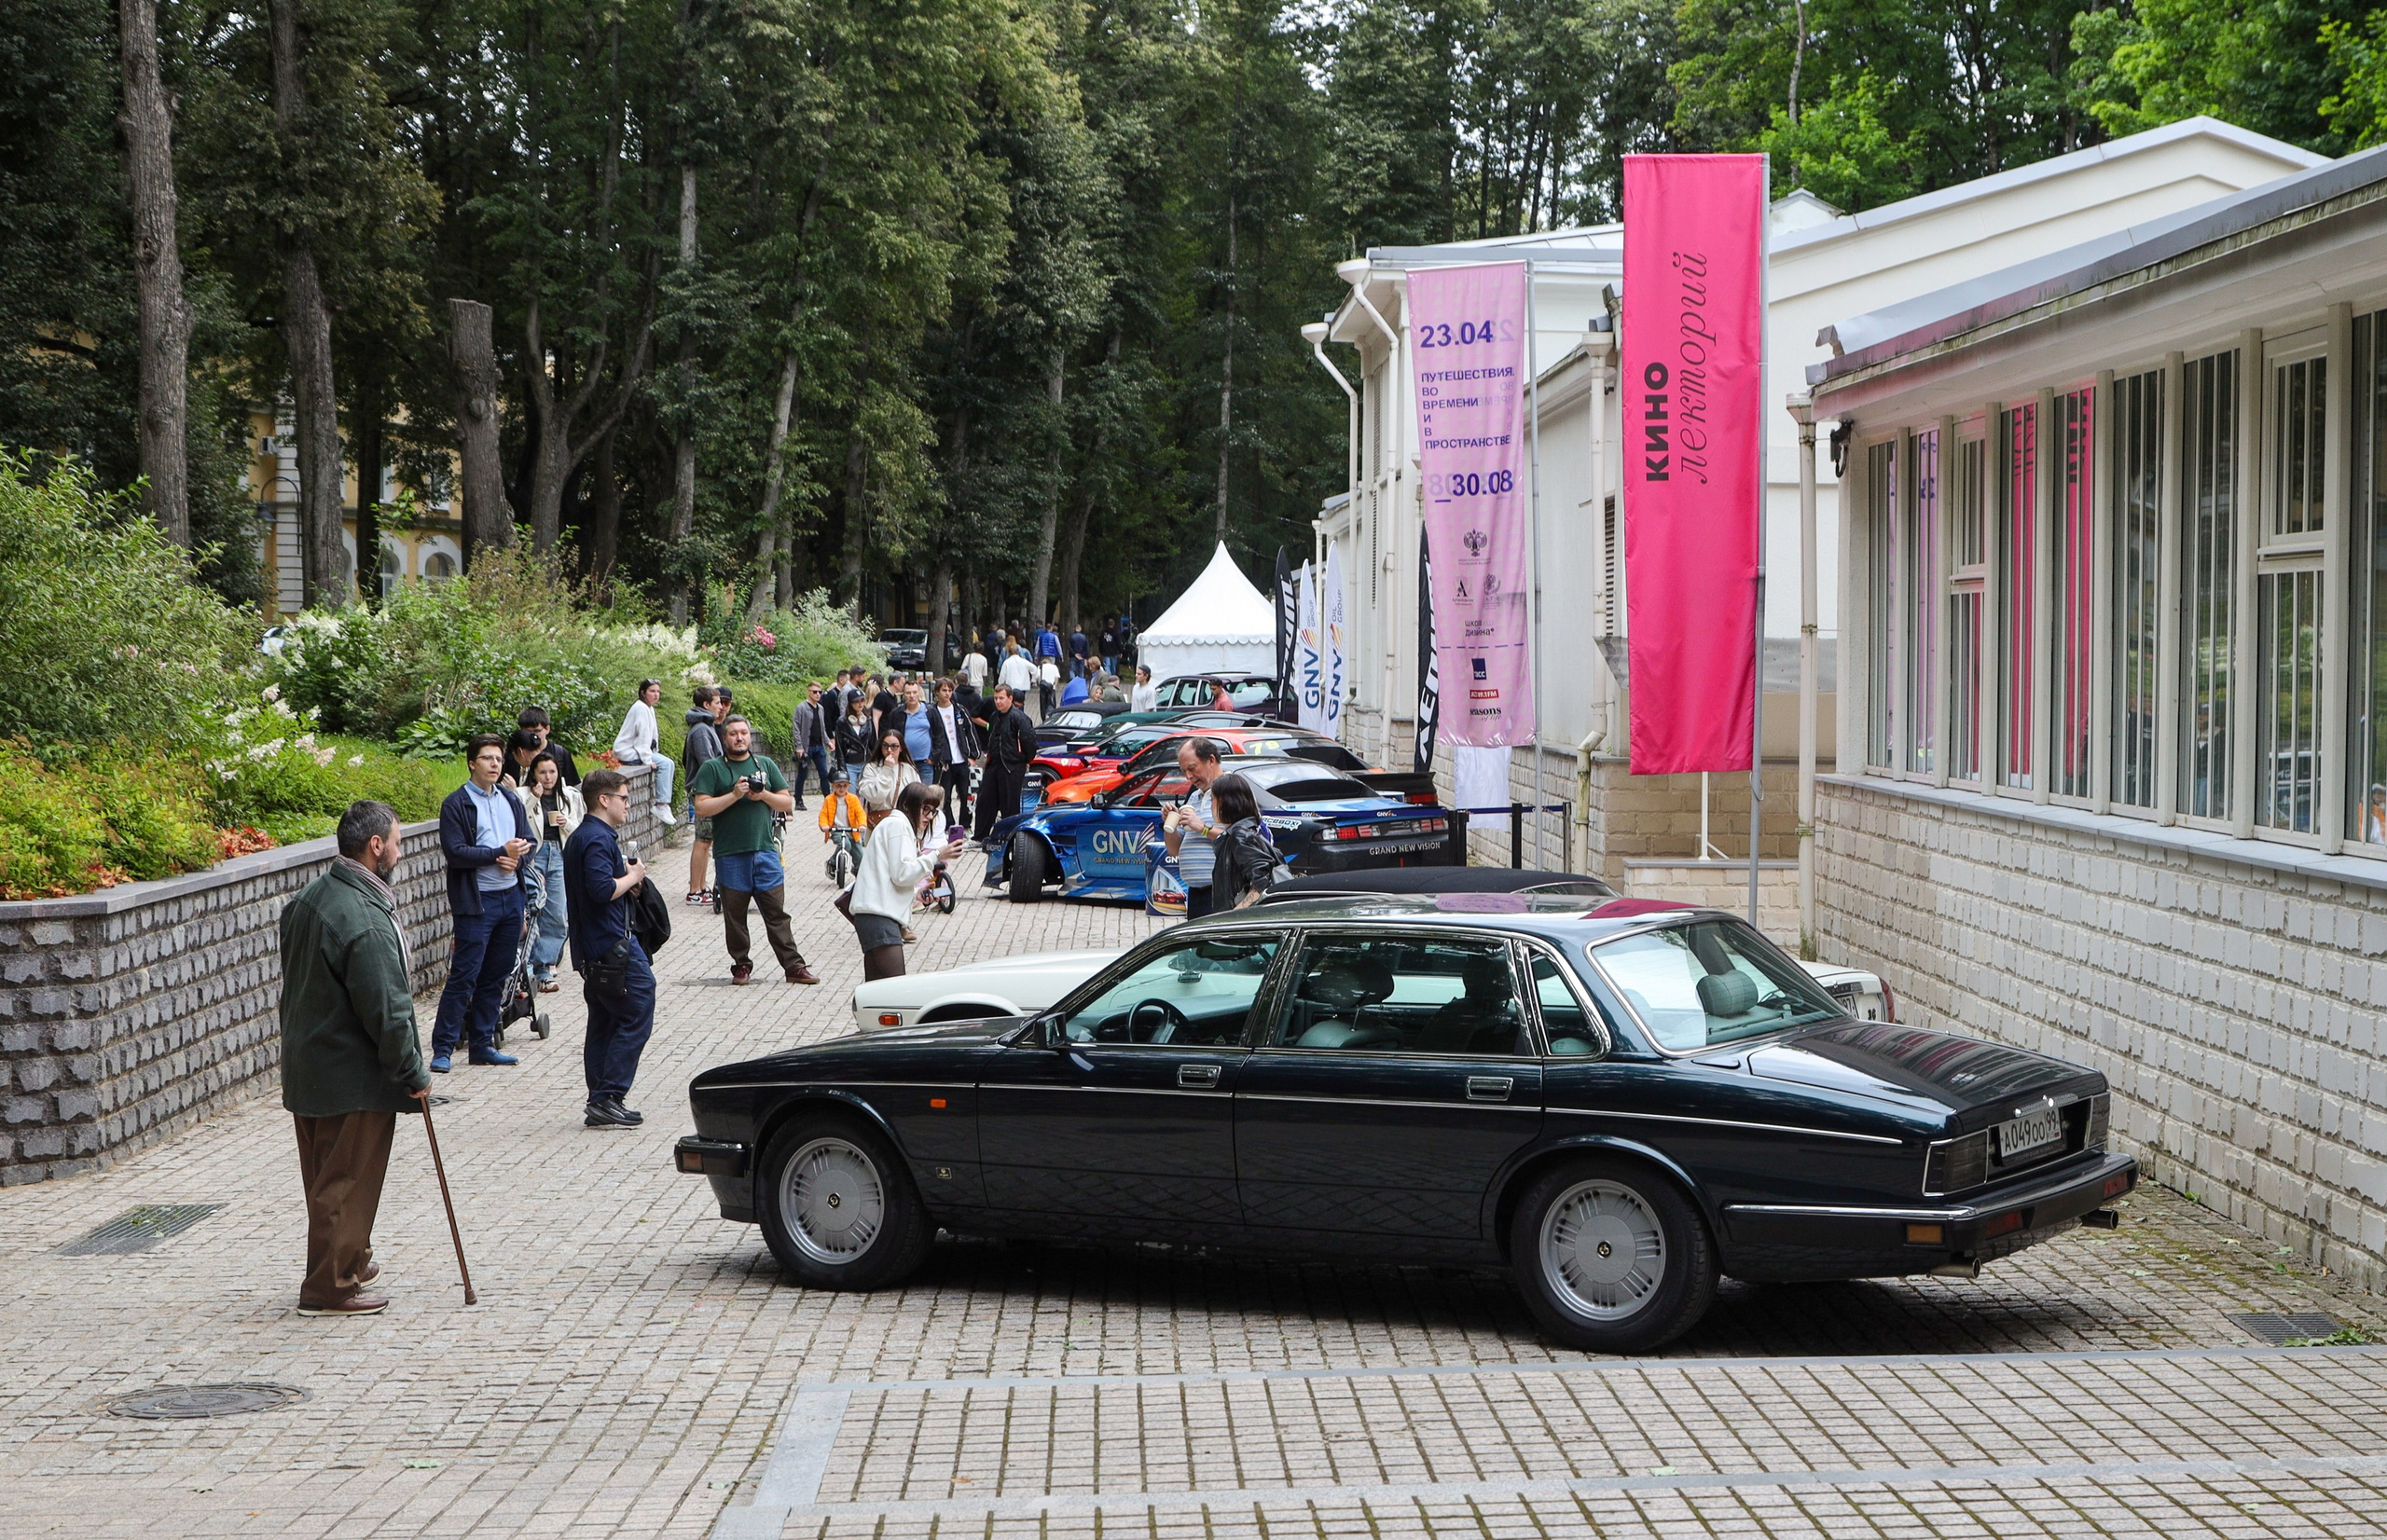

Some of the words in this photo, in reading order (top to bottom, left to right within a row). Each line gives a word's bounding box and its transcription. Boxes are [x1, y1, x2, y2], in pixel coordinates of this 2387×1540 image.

[1420, 320, 1493, 348] 23.04
[1421, 366, 1513, 382] ПУТЕШЕСТВИЯ
[1672, 251, 1717, 485] лекторий
[1422, 387, 1439, 396] ВО
[1423, 397, 1479, 410] ВРЕМЕНИ
[1423, 414, 1431, 423] И
[1644, 362, 1669, 482] КИНО
[1424, 427, 1432, 436] В
[1425, 434, 1511, 449] ПРОСТРАНСТВЕ
[1452, 469, 1513, 497] 30.08
[1304, 648, 1320, 708] GNV
[1328, 648, 1342, 722] GNV
[1249, 740, 1280, 756] 79
[1092, 830, 1141, 854] GNV
[1369, 846, 1397, 855] GRAND
[1399, 844, 1416, 853] NEW
[1417, 841, 1441, 851] VISION
